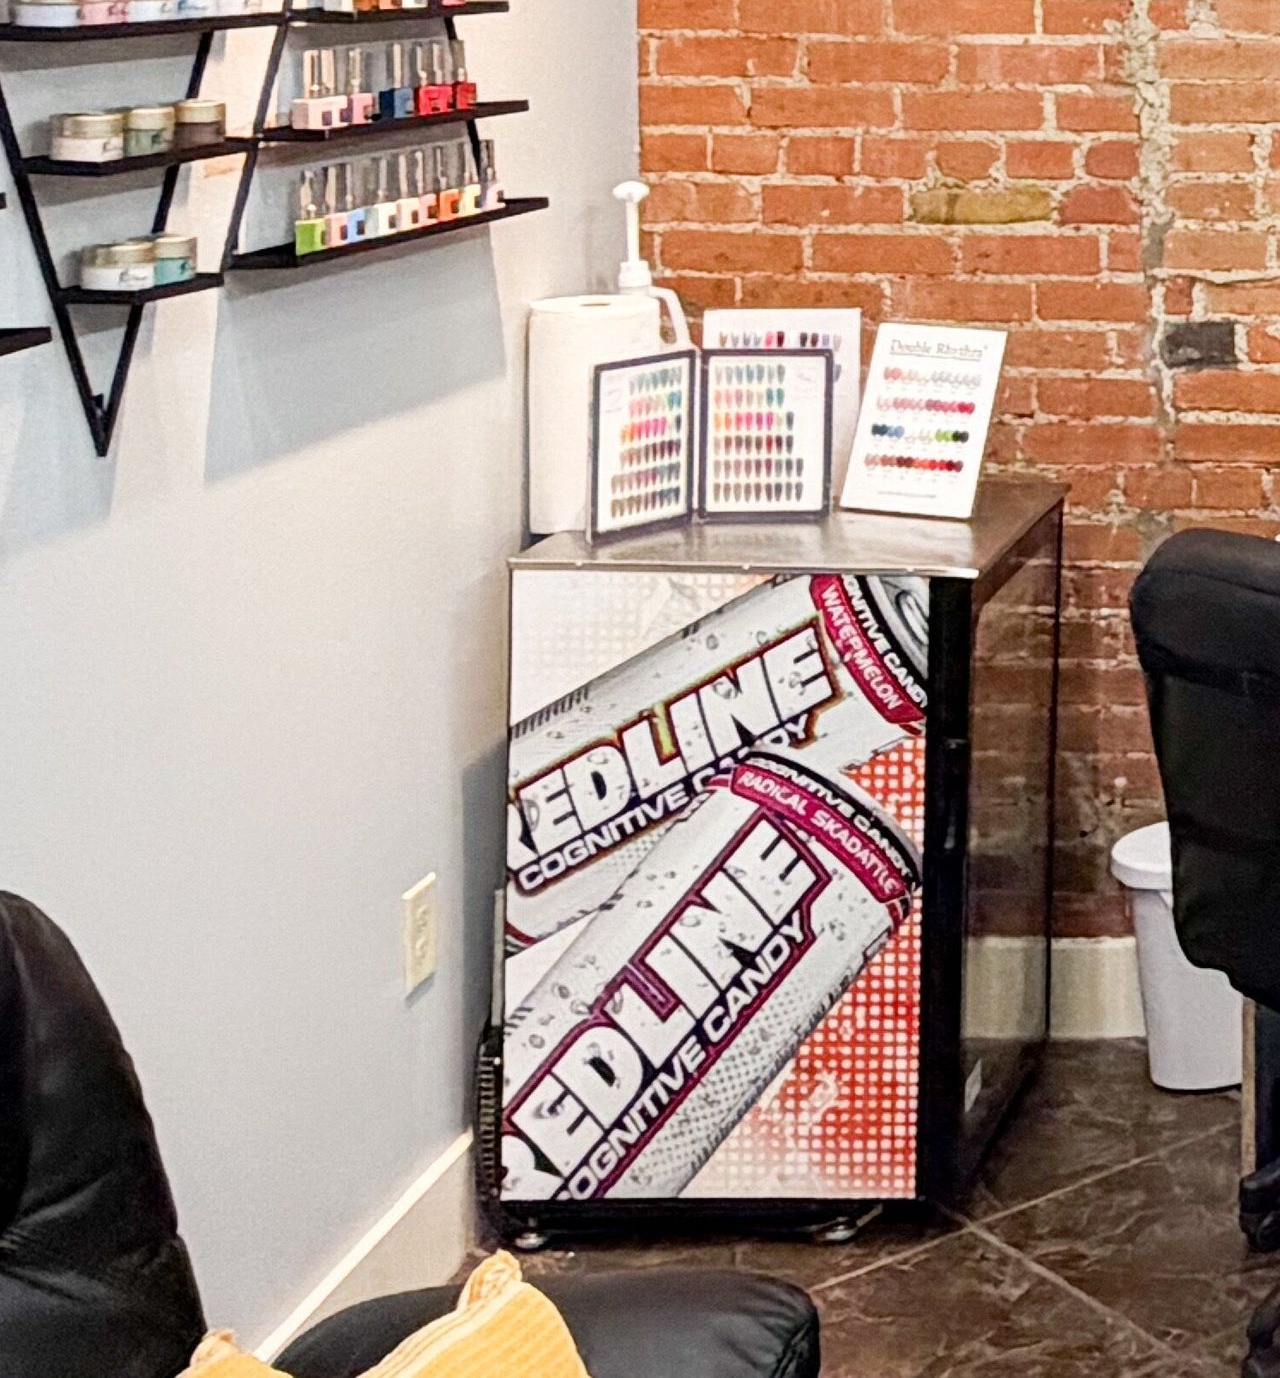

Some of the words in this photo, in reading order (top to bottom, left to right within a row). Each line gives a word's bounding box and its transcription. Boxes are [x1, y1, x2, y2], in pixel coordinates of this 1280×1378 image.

[821, 584, 904, 710] WATERMELON
[518, 782, 690, 891] COGNITIVE
[692, 713, 808, 795] CDY
[738, 771, 809, 816] RADICAL
[810, 810, 900, 896] SKADATTLE
[555, 1038, 706, 1200] OGNITIVE
[703, 910, 806, 1044] CANDY
